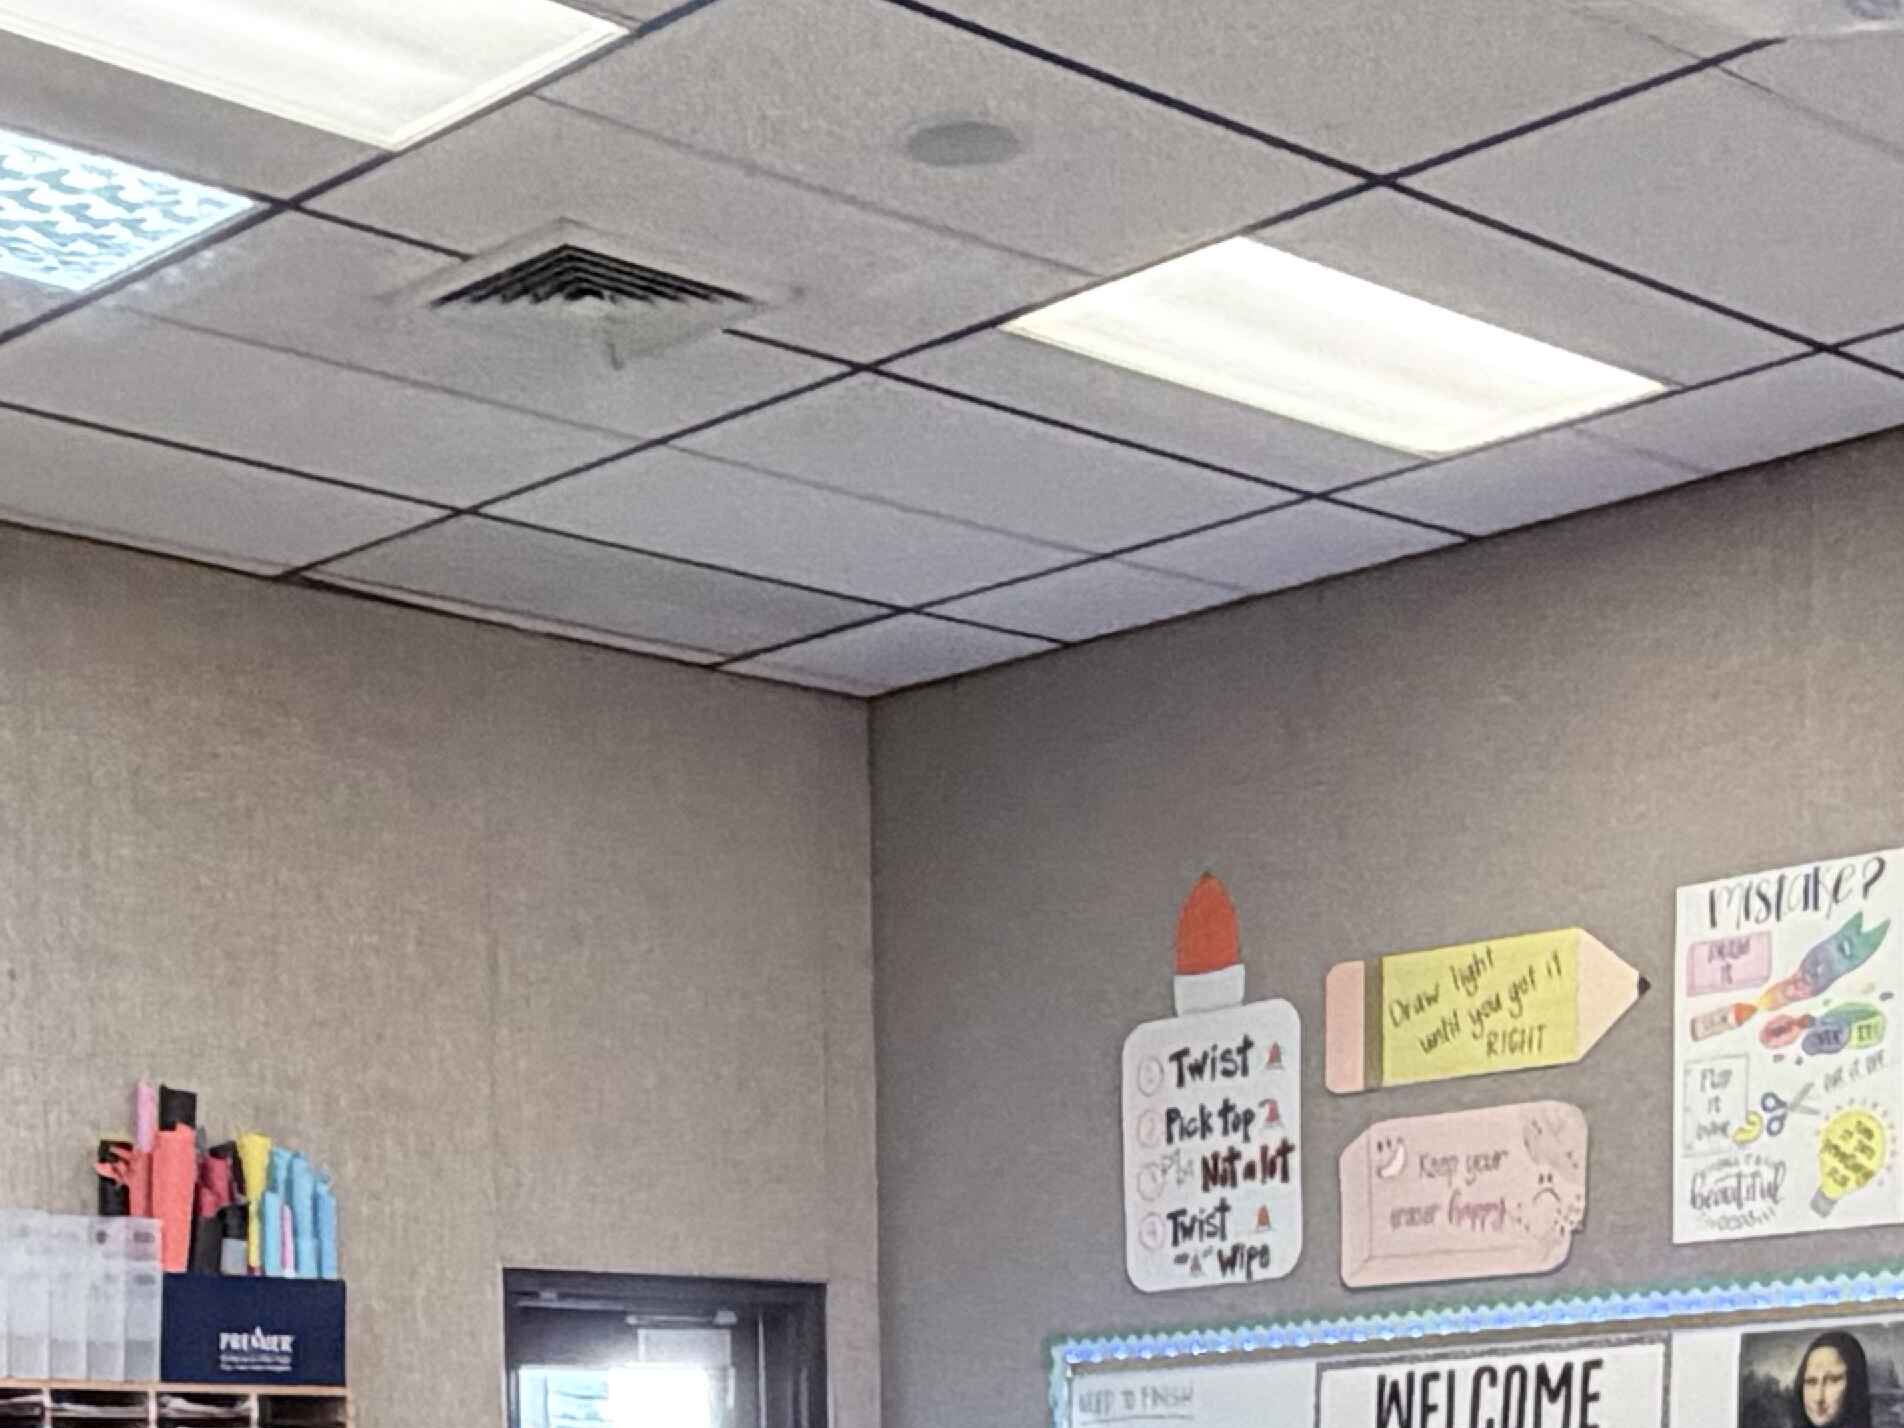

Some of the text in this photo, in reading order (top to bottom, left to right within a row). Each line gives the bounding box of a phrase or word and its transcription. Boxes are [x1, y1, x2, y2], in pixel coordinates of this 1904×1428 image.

[1388, 945, 1495, 1029] Draw light
[1418, 1007, 1462, 1055] until
[1468, 990, 1502, 1040] you
[1486, 1024, 1548, 1058] RIGHT
[1168, 1035, 1254, 1088] Twist
[1165, 1098, 1256, 1144] Pick top
[1201, 1146, 1242, 1192] Not
[1243, 1159, 1257, 1181] a
[1260, 1137, 1296, 1184] lot
[1418, 1149, 1509, 1188] Keep your
[1166, 1197, 1231, 1247] Twist
[1217, 1242, 1271, 1281] Wipe
